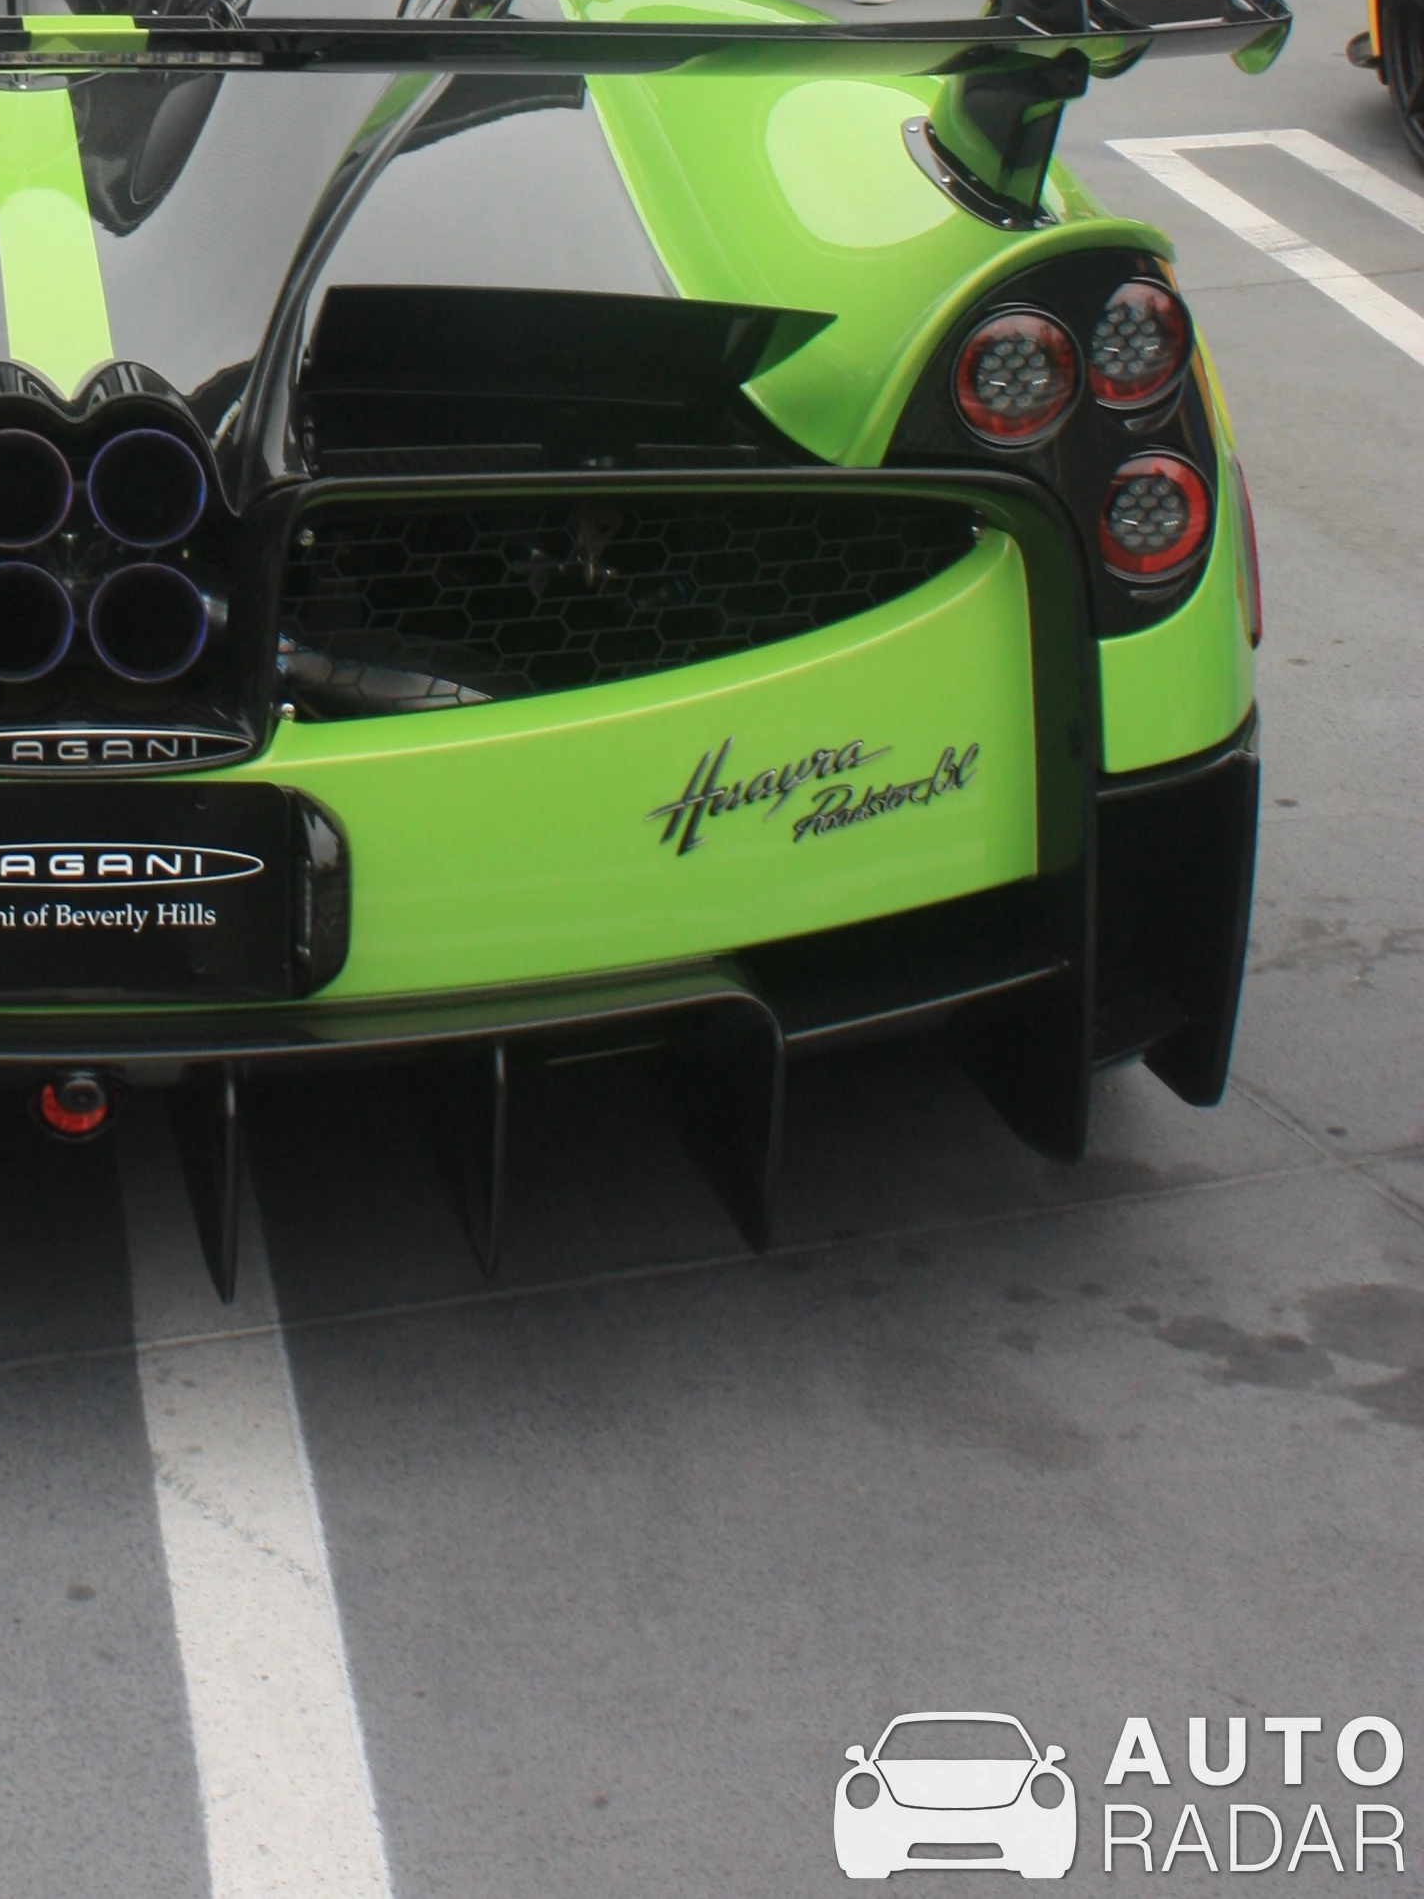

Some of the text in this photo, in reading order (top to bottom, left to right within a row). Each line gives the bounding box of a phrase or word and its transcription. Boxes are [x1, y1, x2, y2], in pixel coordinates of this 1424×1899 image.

[644, 735, 893, 857] Huayra
[23, 904, 49, 927] of
[56, 904, 149, 931] Beverly
[157, 903, 217, 926] Hills
